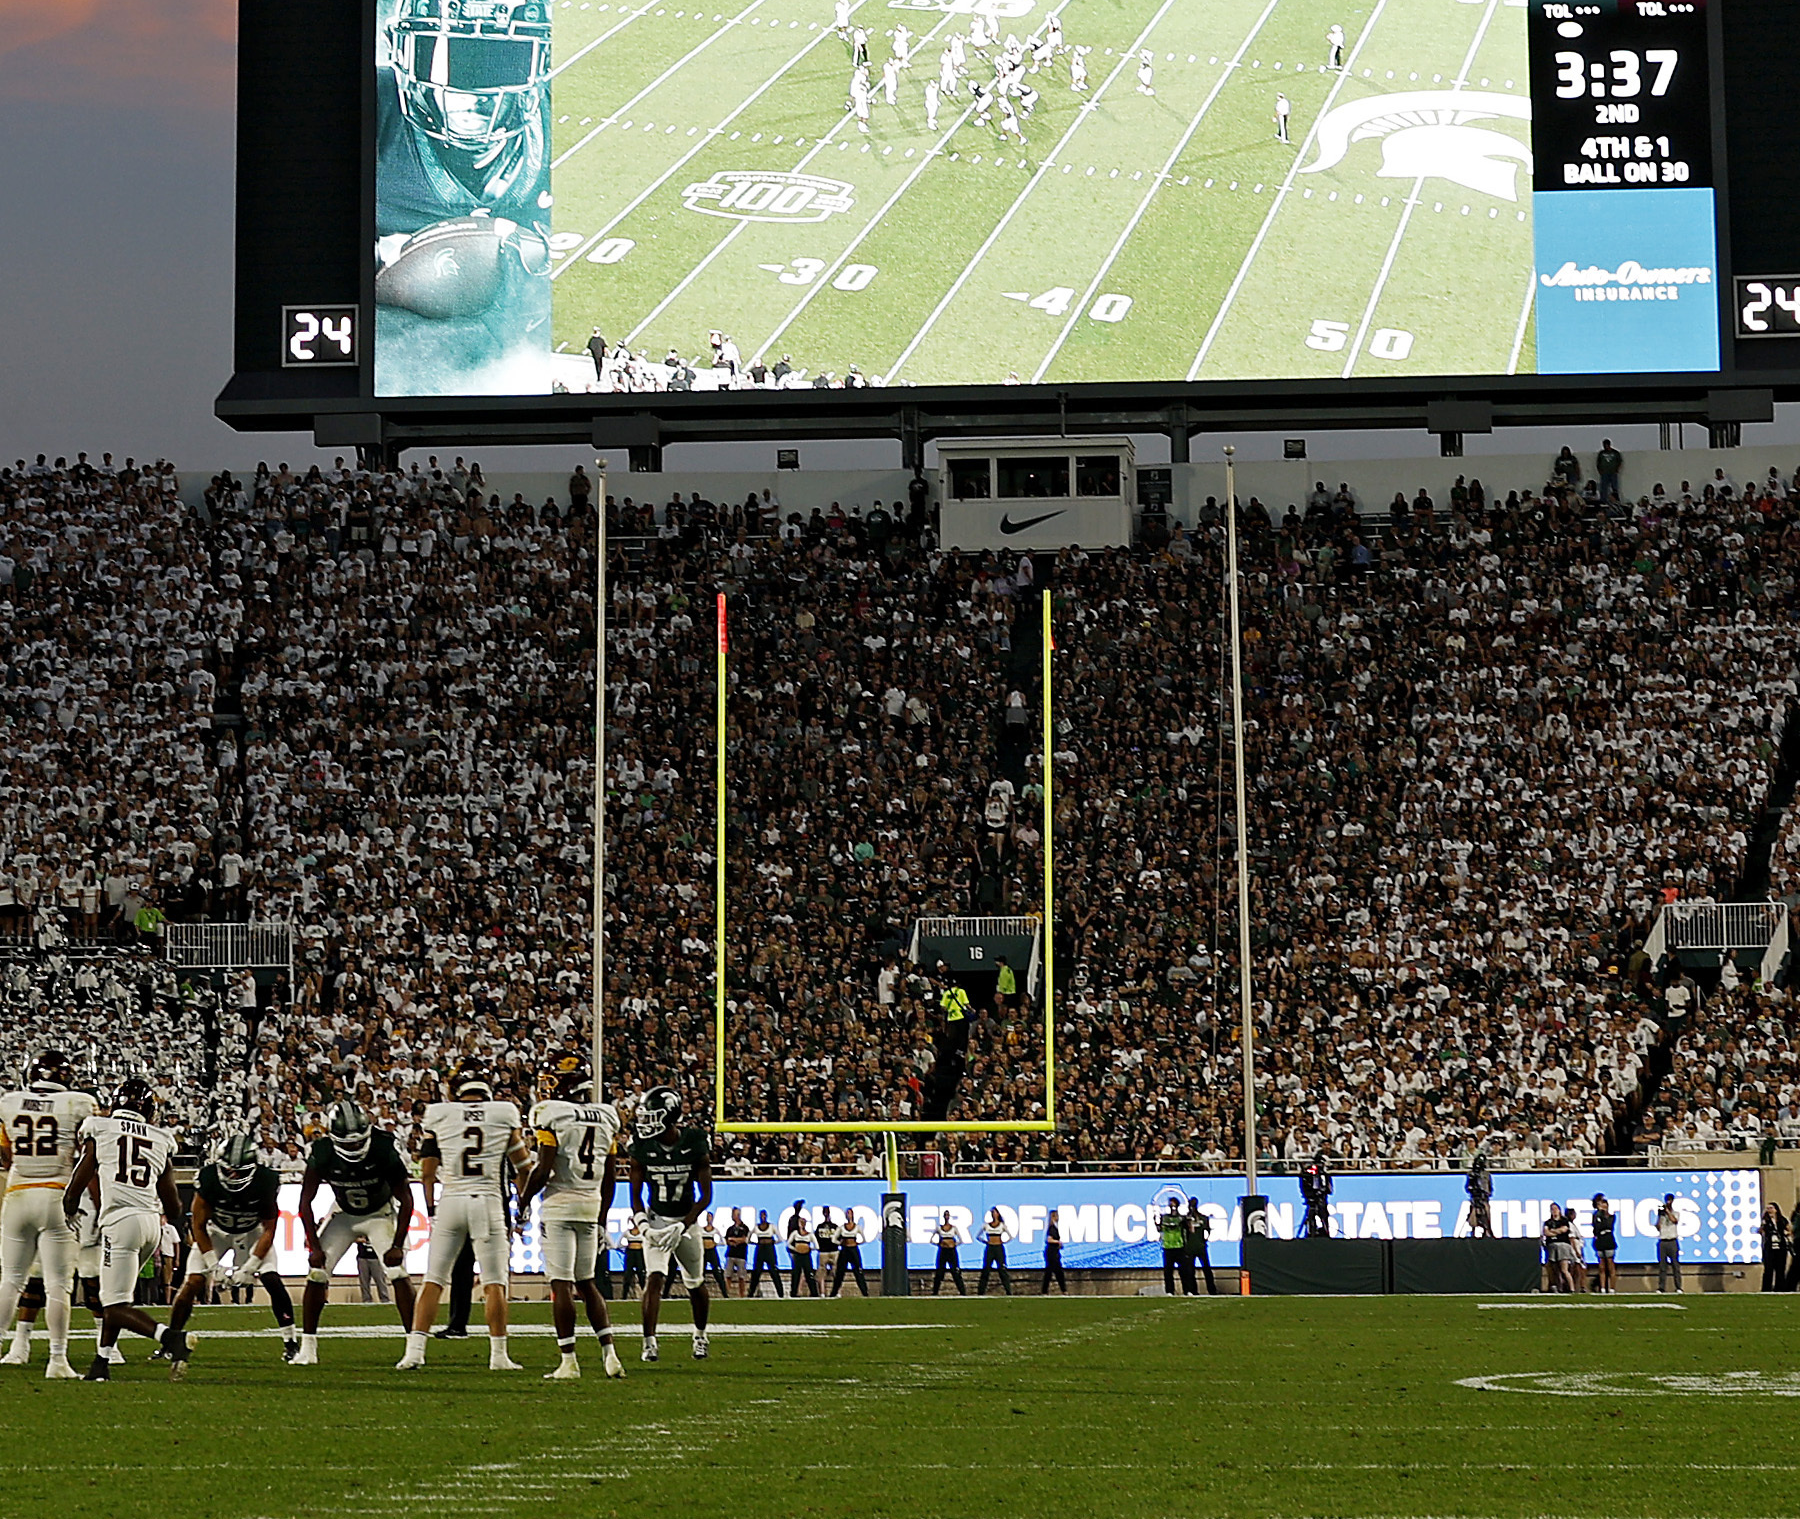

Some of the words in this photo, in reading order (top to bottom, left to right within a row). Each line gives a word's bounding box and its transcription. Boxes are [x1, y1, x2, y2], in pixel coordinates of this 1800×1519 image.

[1543, 4, 1573, 19] TOL
[1636, 2, 1667, 17] TOL
[1555, 49, 1679, 99] 3:37
[1595, 104, 1640, 123] 2ND
[1580, 137, 1630, 158] 4TH
[1634, 137, 1653, 158] &
[1656, 136, 1670, 157] 1
[1563, 163, 1621, 184] BALL
[1624, 162, 1657, 182] ON
[1661, 161, 1689, 182] 30
[718, 182, 818, 214] 100
[1540, 261, 1712, 286] Auto-Owners
[1575, 286, 1678, 301] INSURANCE
[290, 313, 351, 359] 24
[969, 947, 983, 960] 16
[12, 1114, 58, 1156] 22
[120, 1120, 148, 1137] SPANN
[114, 1135, 153, 1188] 15
[462, 1126, 484, 1176] 2
[577, 1125, 595, 1180] 4
[346, 1189, 369, 1209] 6
[651, 1172, 690, 1202] 17
[778, 1205, 973, 1243] GROER
[984, 1204, 1047, 1243] OF
[1058, 1203, 1293, 1242] MICGN
